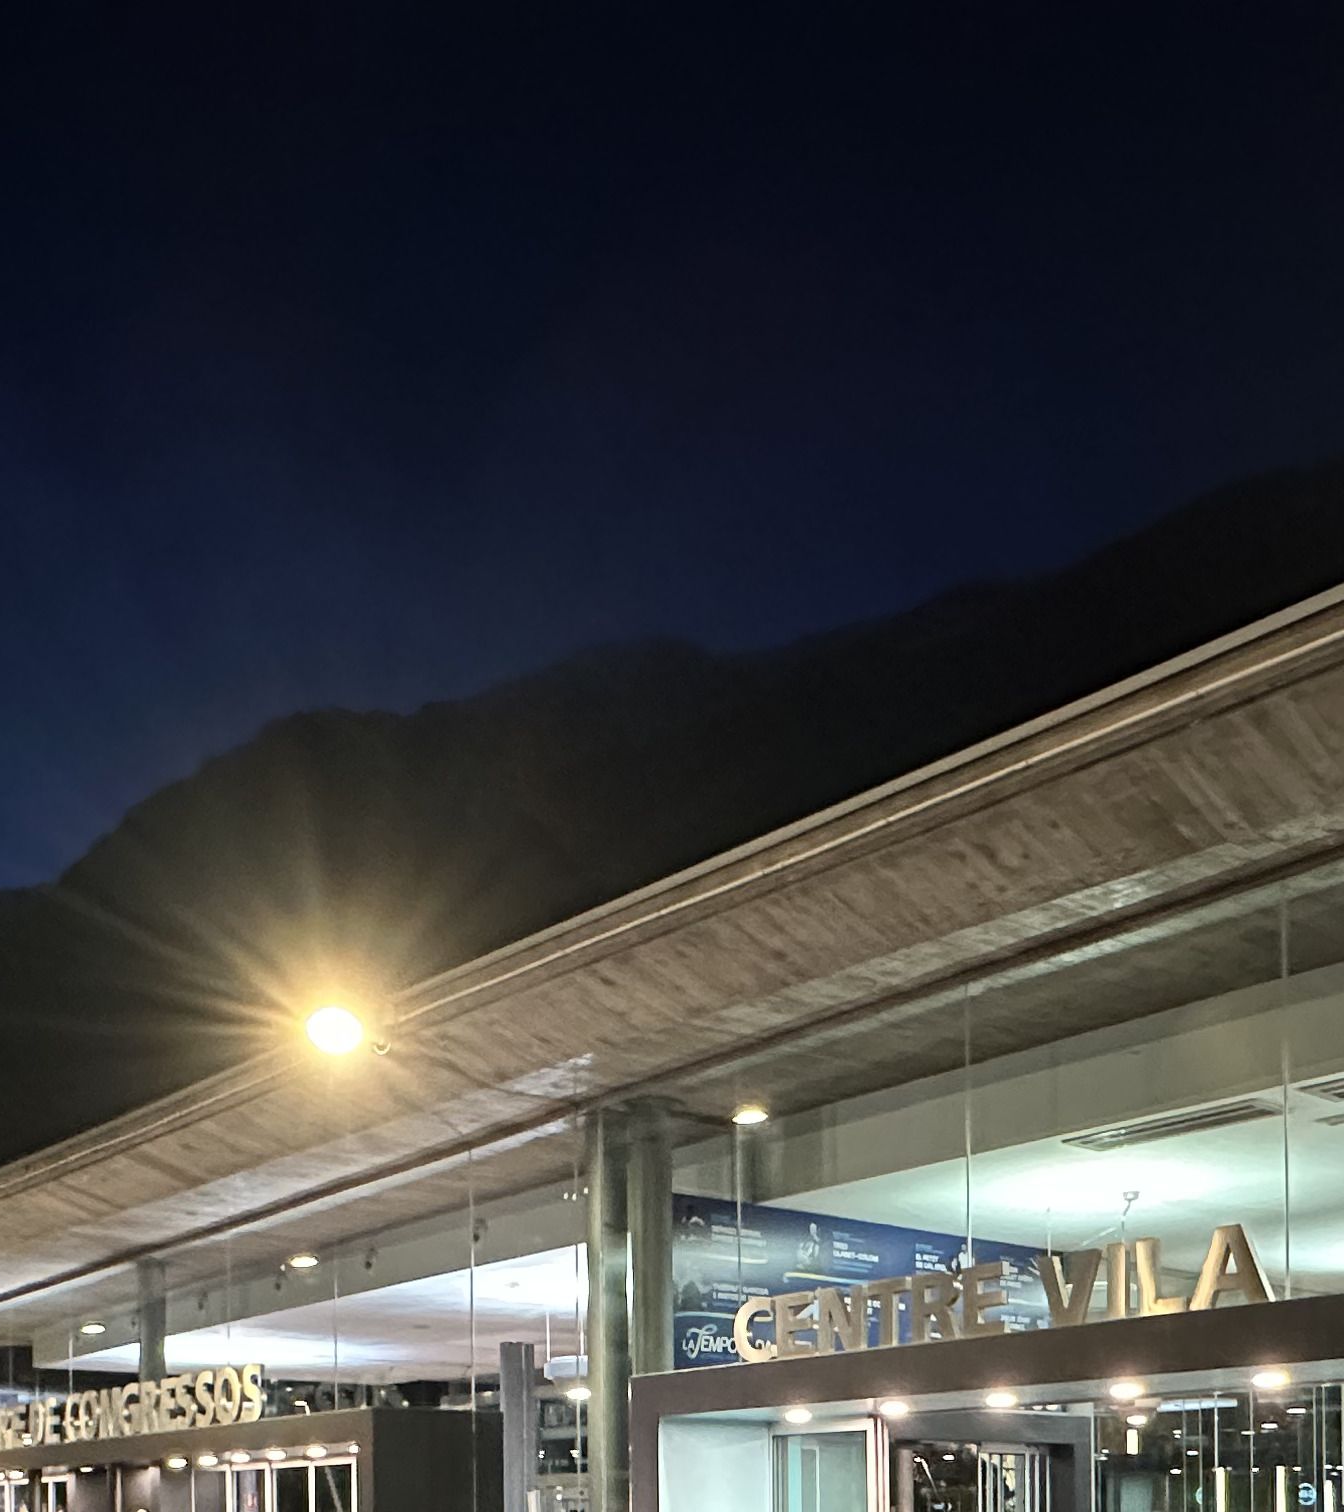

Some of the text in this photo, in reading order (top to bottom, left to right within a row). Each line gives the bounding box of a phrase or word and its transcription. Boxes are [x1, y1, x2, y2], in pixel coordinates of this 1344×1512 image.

[734, 1224, 1276, 1363] CENTRE VILA
[29, 1396, 61, 1446] DE
[62, 1363, 265, 1444] CONGRESSOS
